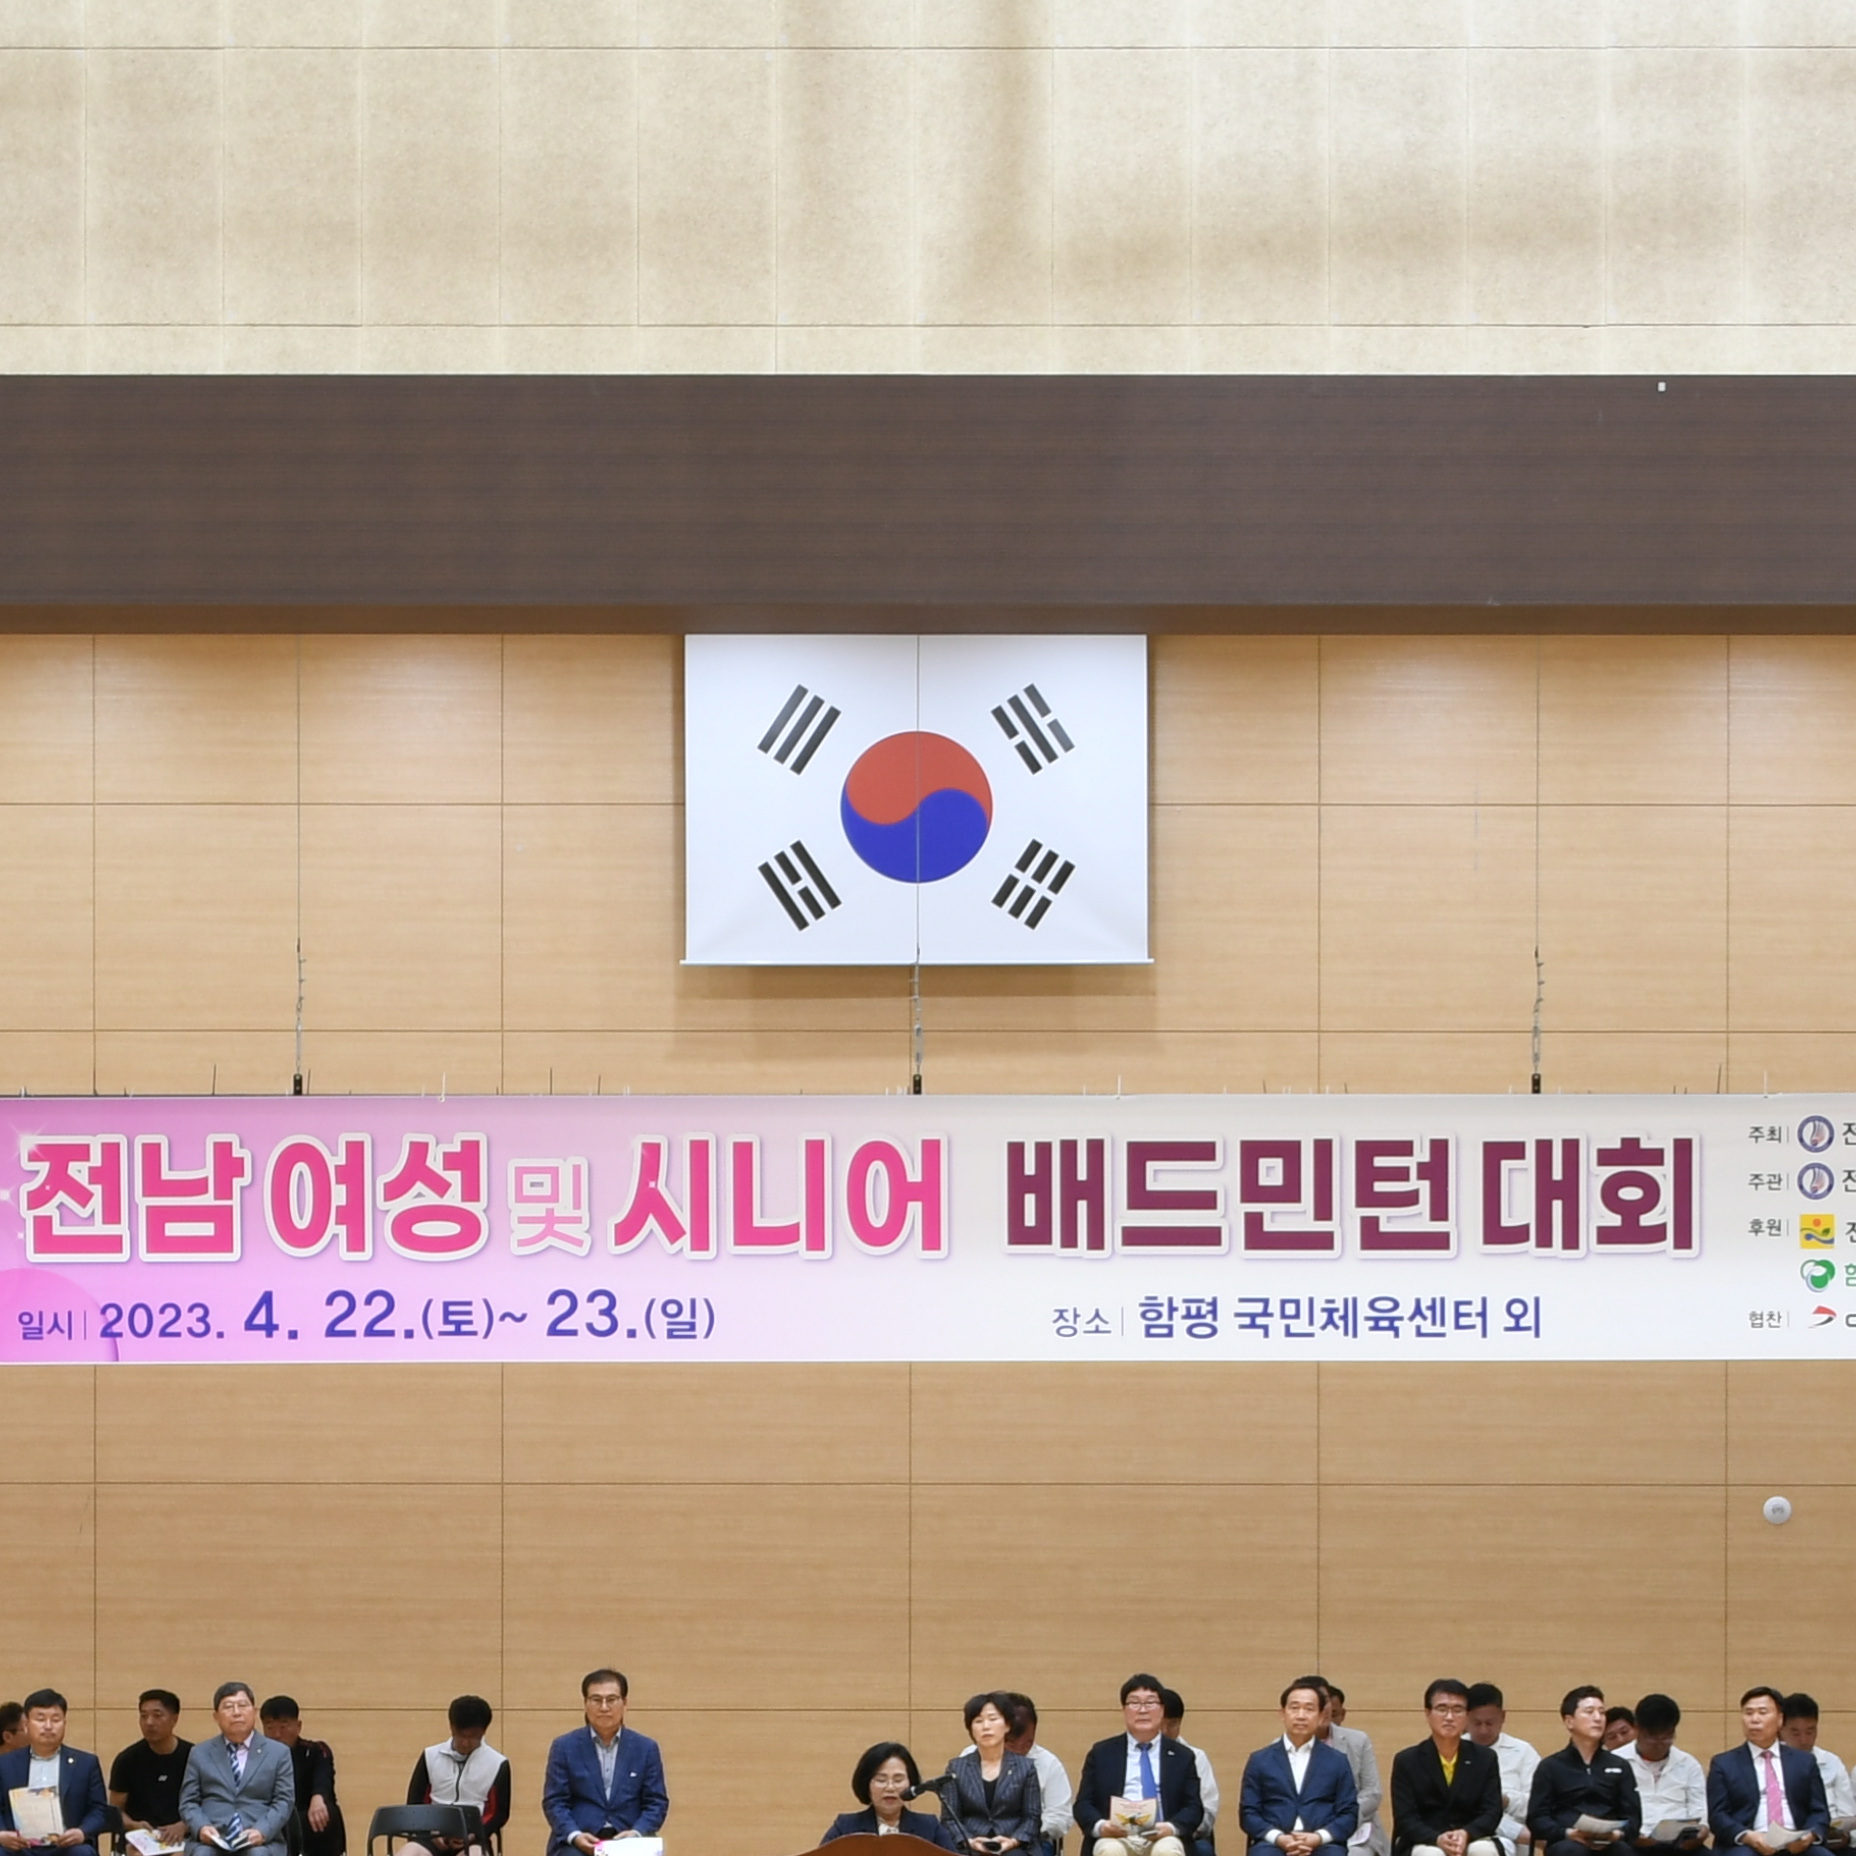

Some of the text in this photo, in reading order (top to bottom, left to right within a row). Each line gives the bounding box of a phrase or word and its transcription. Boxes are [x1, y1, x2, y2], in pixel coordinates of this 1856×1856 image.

[1748, 1125, 1783, 1144] 주최
[1748, 1172, 1783, 1191] 주관
[21, 1133, 249, 1262] 전남
[266, 1133, 491, 1262] 여성
[508, 1154, 589, 1257] 및
[611, 1133, 950, 1262] 시니어
[1001, 1132, 1459, 1262] 배드민턴
[1477, 1132, 1702, 1262] 대회
[1748, 1218, 1783, 1238] 후원
[17, 1308, 75, 1341] 일시
[99, 1301, 225, 1340] 2023.
[244, 1288, 300, 1340] 4.
[546, 1290, 717, 1344] 23.(일)
[1051, 1295, 1544, 1342] 장소 함평 국민체육센터 외
[1748, 1310, 1783, 1330] 협찬
